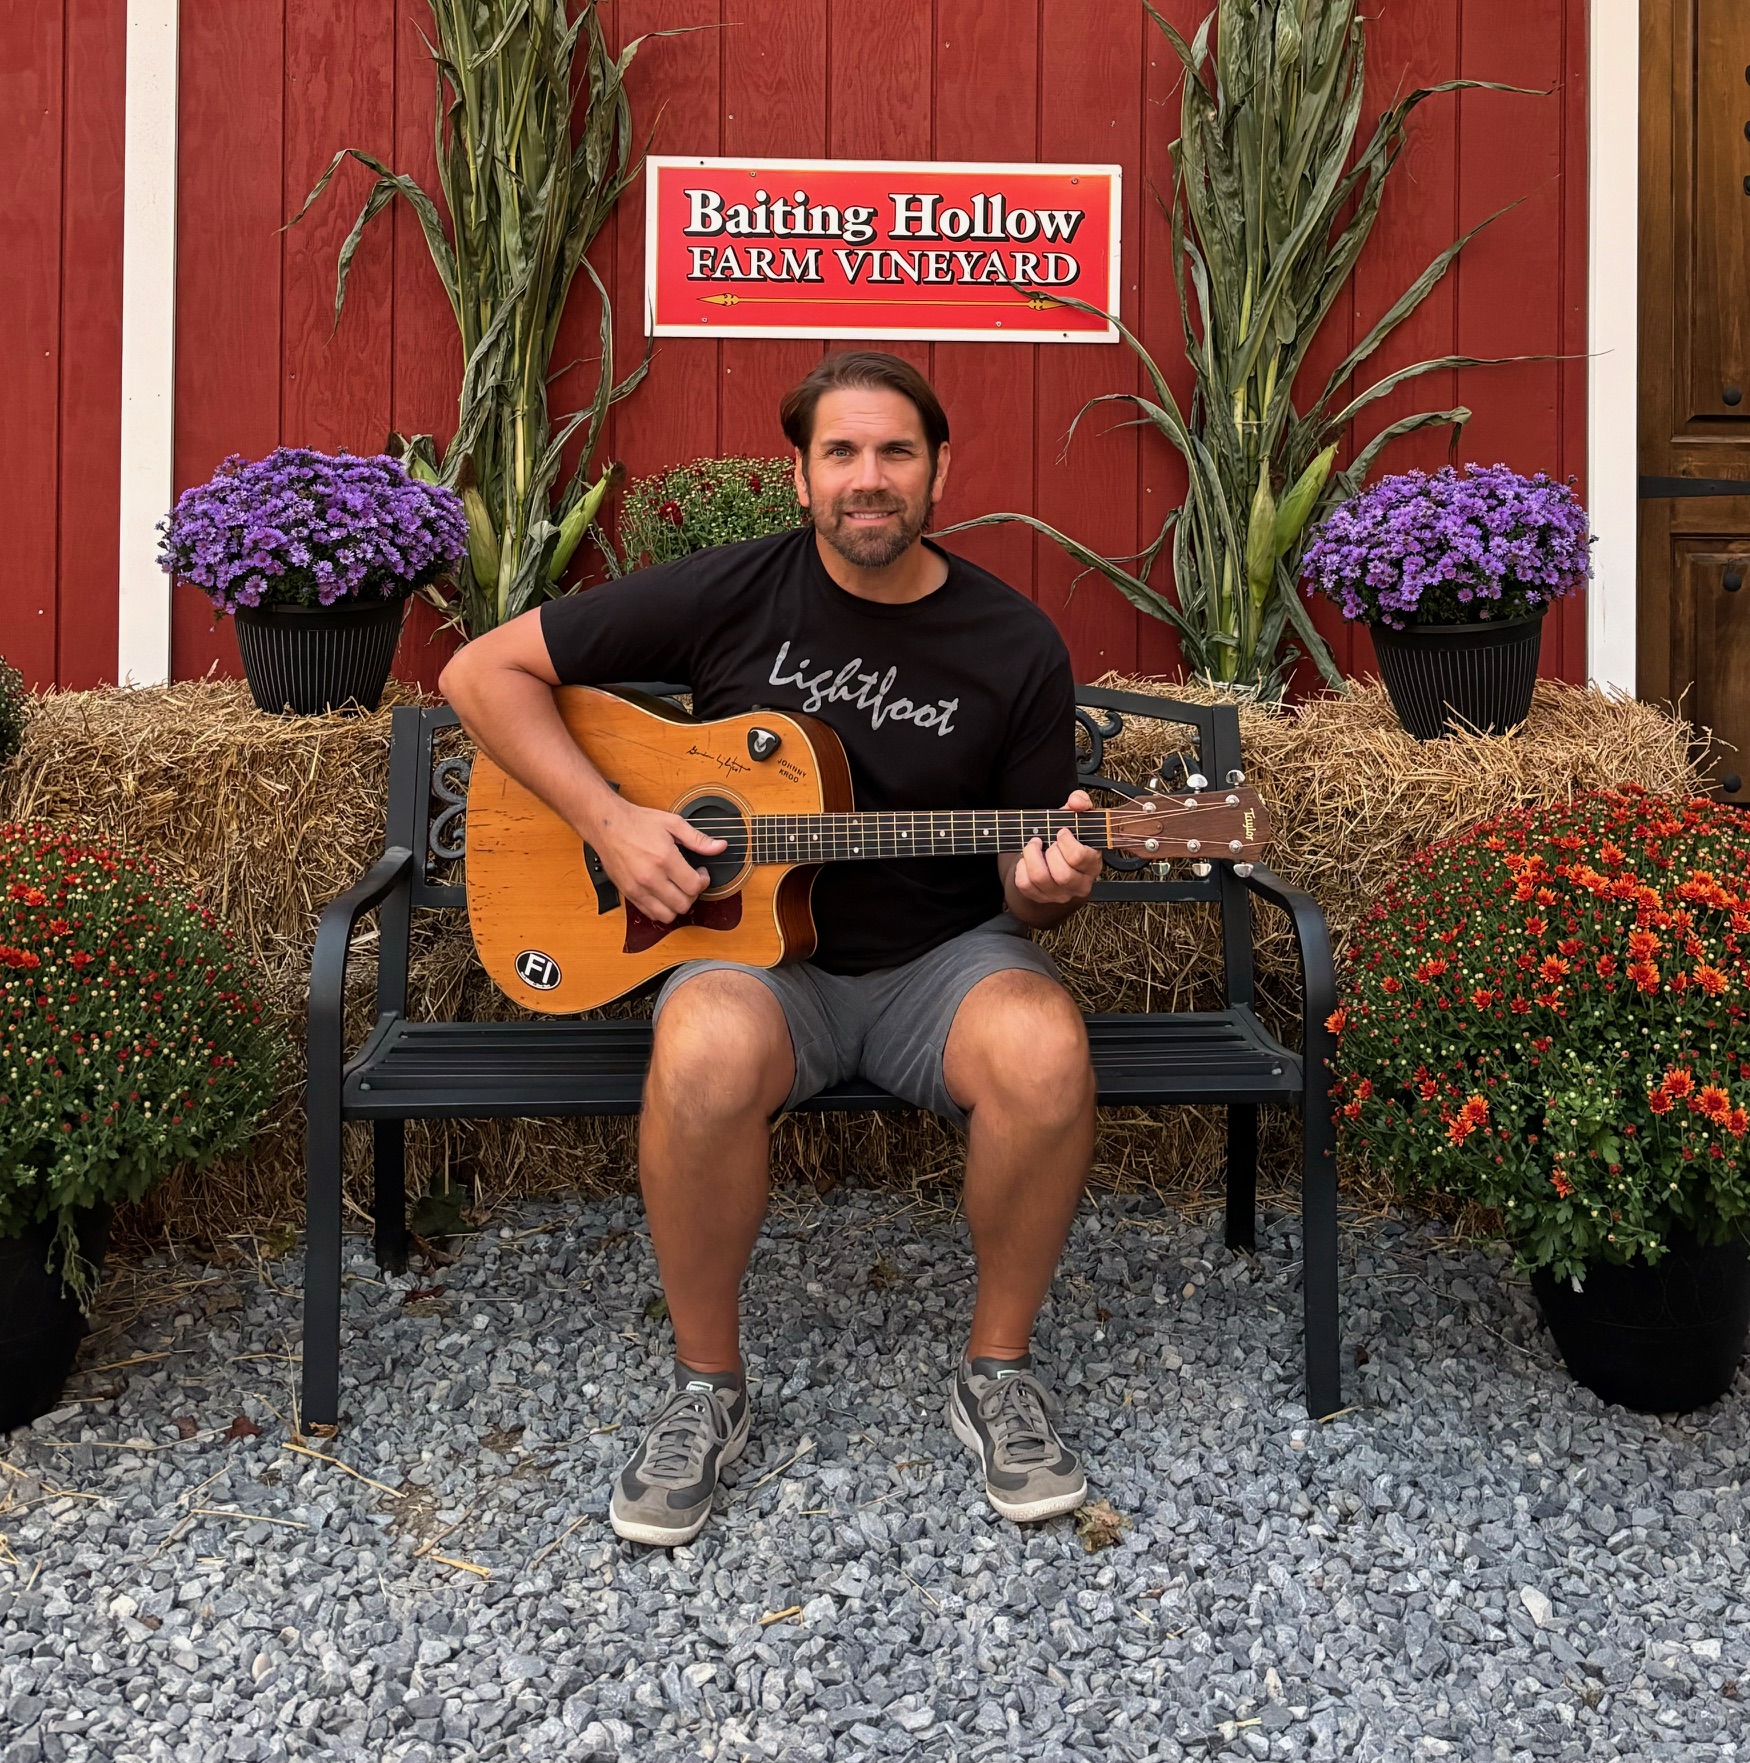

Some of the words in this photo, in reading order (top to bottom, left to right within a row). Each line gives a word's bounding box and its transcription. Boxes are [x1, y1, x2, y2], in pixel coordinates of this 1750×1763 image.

[683, 188, 877, 244] Baiting
[888, 192, 1084, 243] Hollow
[688, 246, 823, 283] FARM
[834, 249, 1081, 285] VINEYARD
[768, 641, 960, 737] Lightfoot
[777, 758, 807, 778] JOHNNY
[1242, 807, 1257, 842] Taylor
